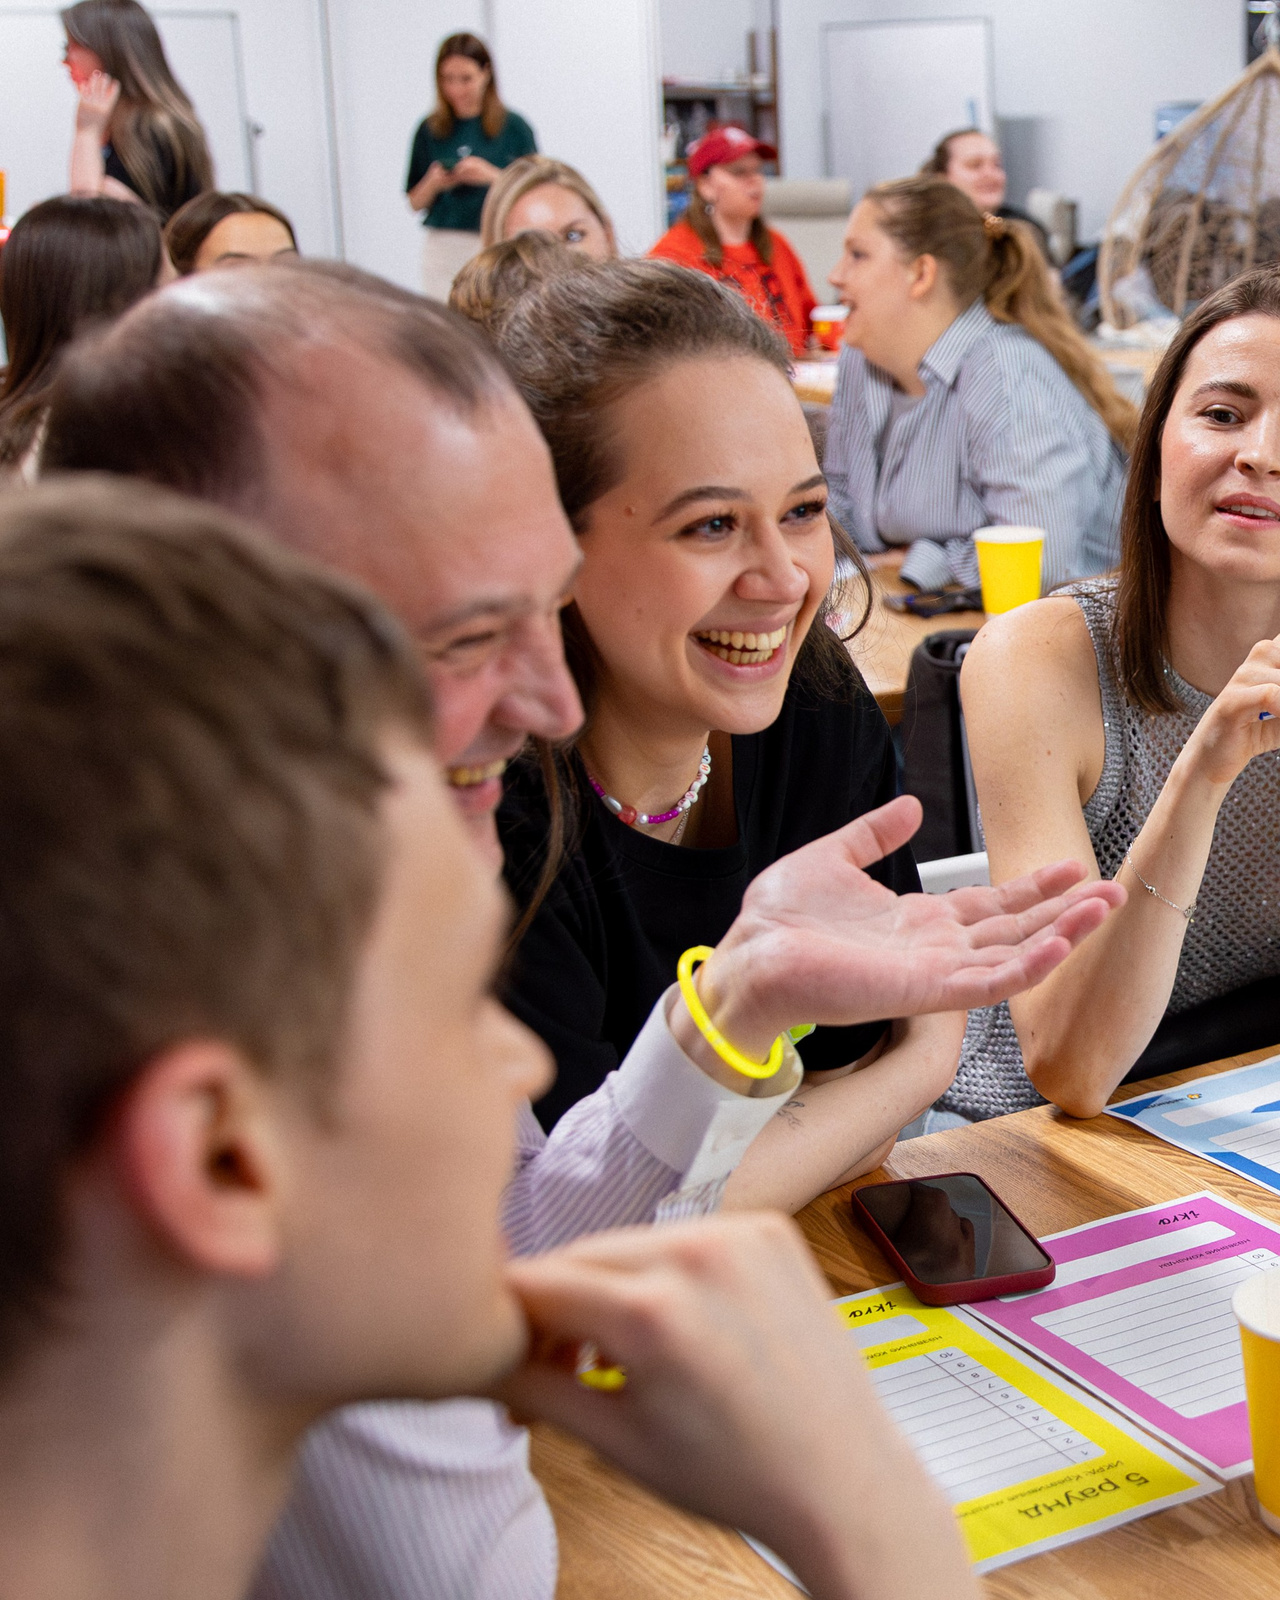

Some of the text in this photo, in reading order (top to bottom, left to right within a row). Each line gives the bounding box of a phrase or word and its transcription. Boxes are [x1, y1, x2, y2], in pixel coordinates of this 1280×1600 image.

[1158, 1209, 1201, 1226] ikra
[1251, 1252, 1265, 1260] 10
[848, 1300, 897, 1318] ikra
[939, 1351, 953, 1359] 10
[1017, 1471, 1150, 1519] 5 раунд
